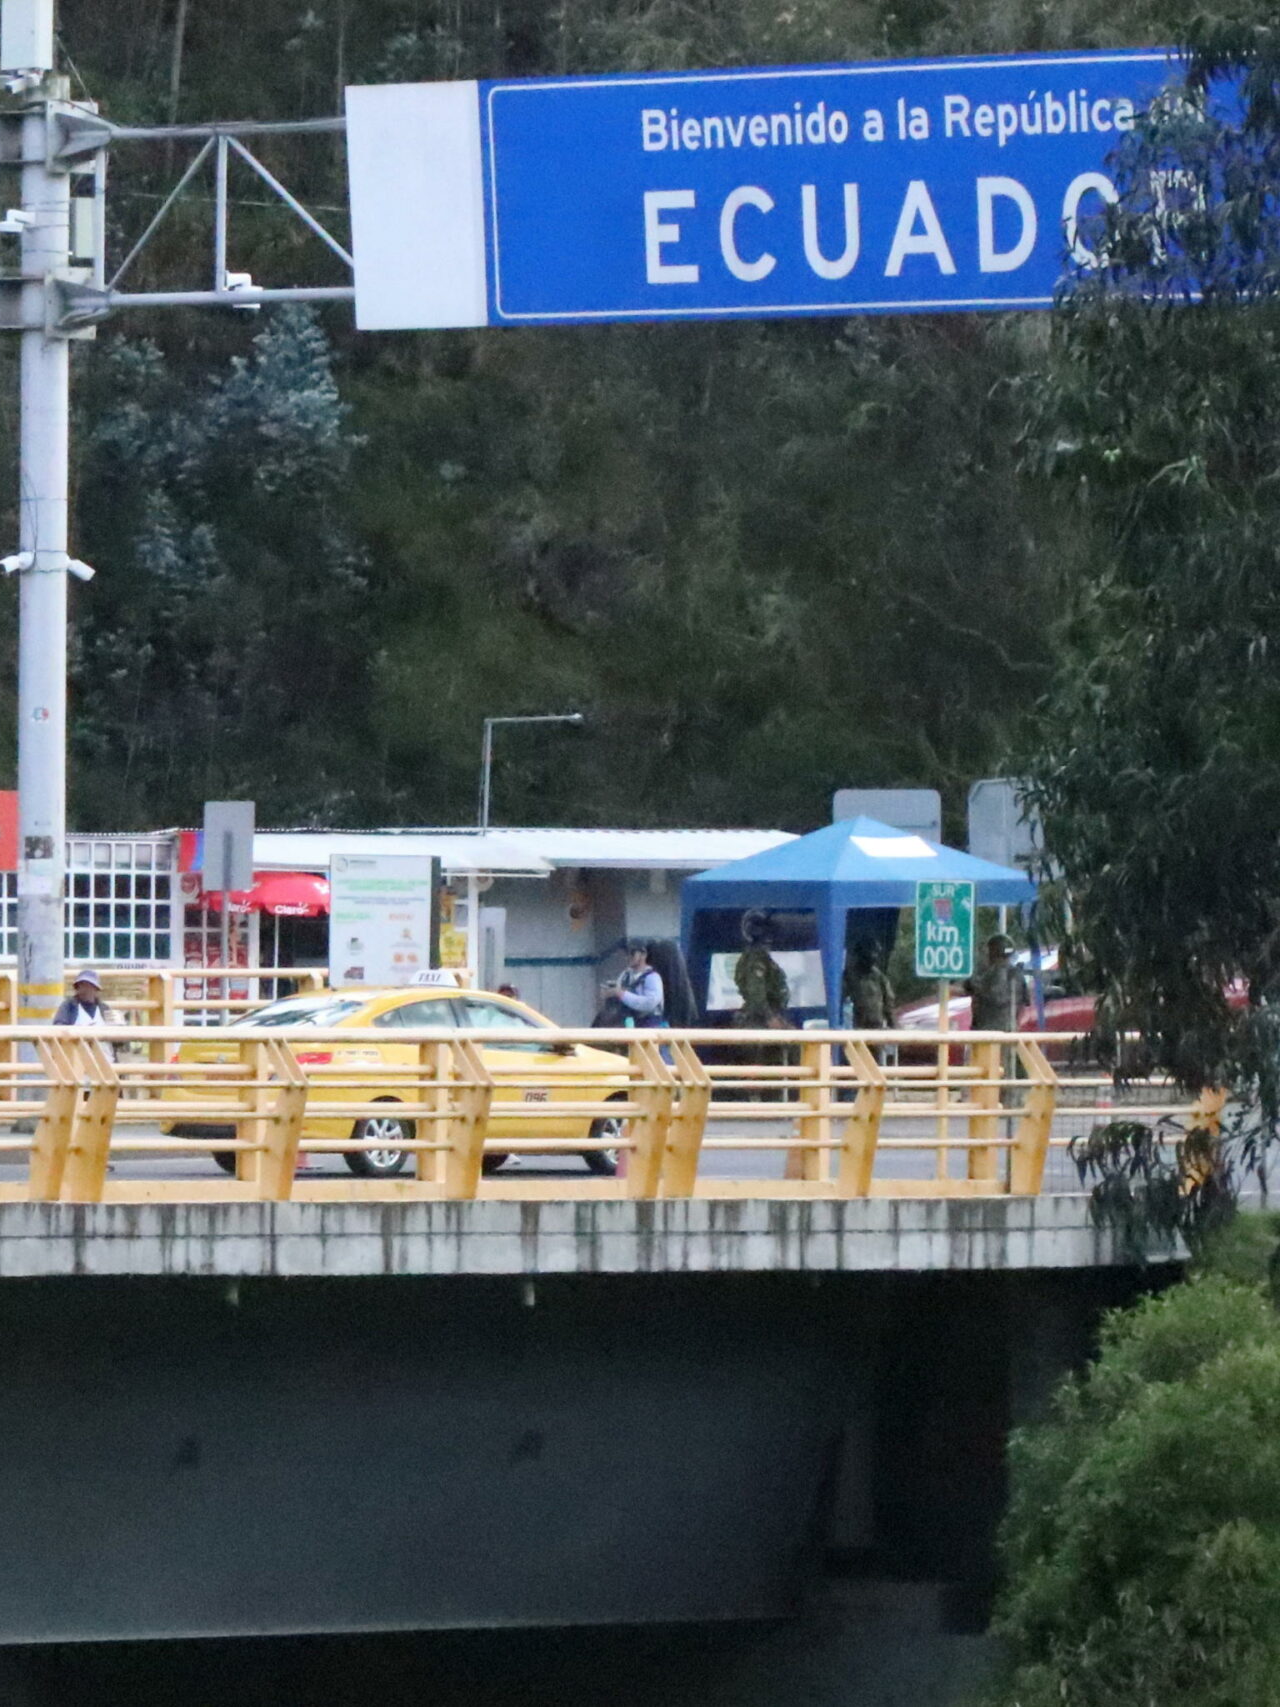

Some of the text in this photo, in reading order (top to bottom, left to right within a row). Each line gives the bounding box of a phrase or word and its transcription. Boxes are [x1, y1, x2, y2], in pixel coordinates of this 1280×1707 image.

[641, 102, 849, 152] Bienvenido
[863, 110, 884, 142] a
[897, 97, 929, 140] la
[943, 88, 1135, 148] República
[274, 903, 306, 915] Claro
[926, 919, 960, 945] km
[924, 945, 964, 972] 000
